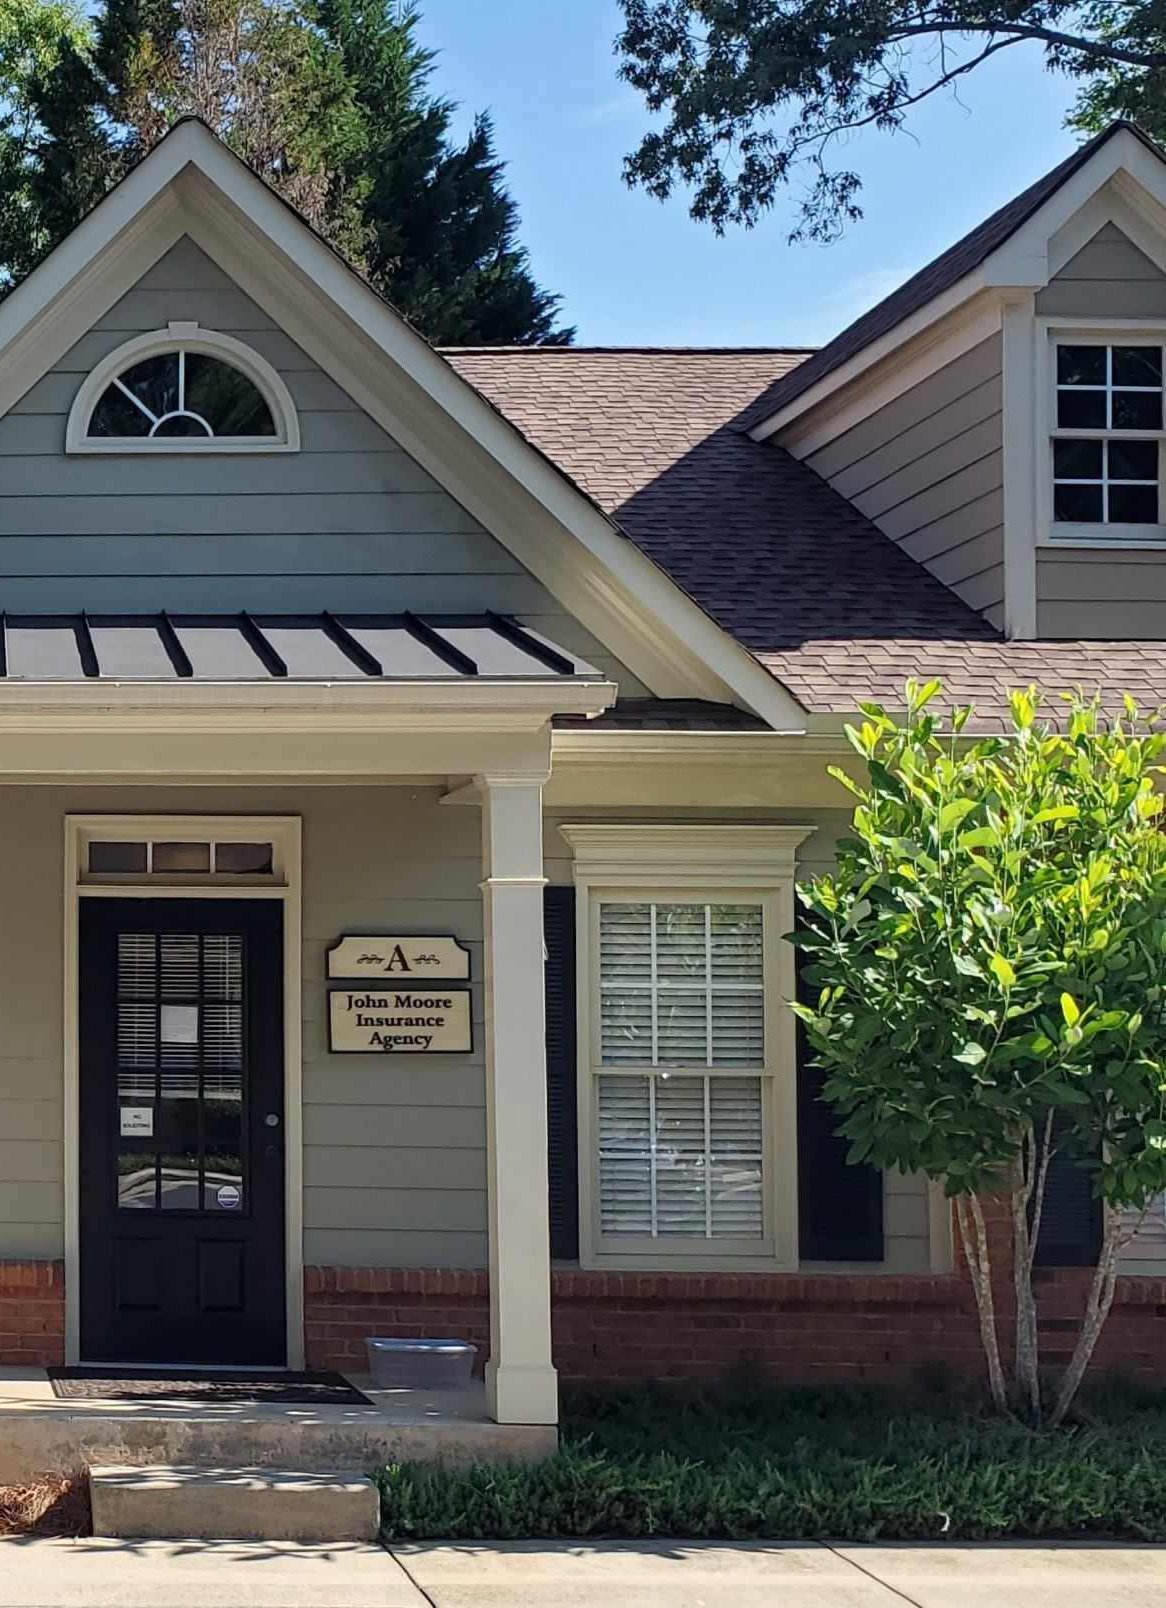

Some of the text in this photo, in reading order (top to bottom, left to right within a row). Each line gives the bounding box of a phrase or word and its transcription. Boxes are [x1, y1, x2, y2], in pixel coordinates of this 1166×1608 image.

[383, 944, 412, 972] A
[346, 995, 452, 1011] John Moore
[355, 1014, 445, 1027] Insurance
[369, 1031, 433, 1050] Agency
